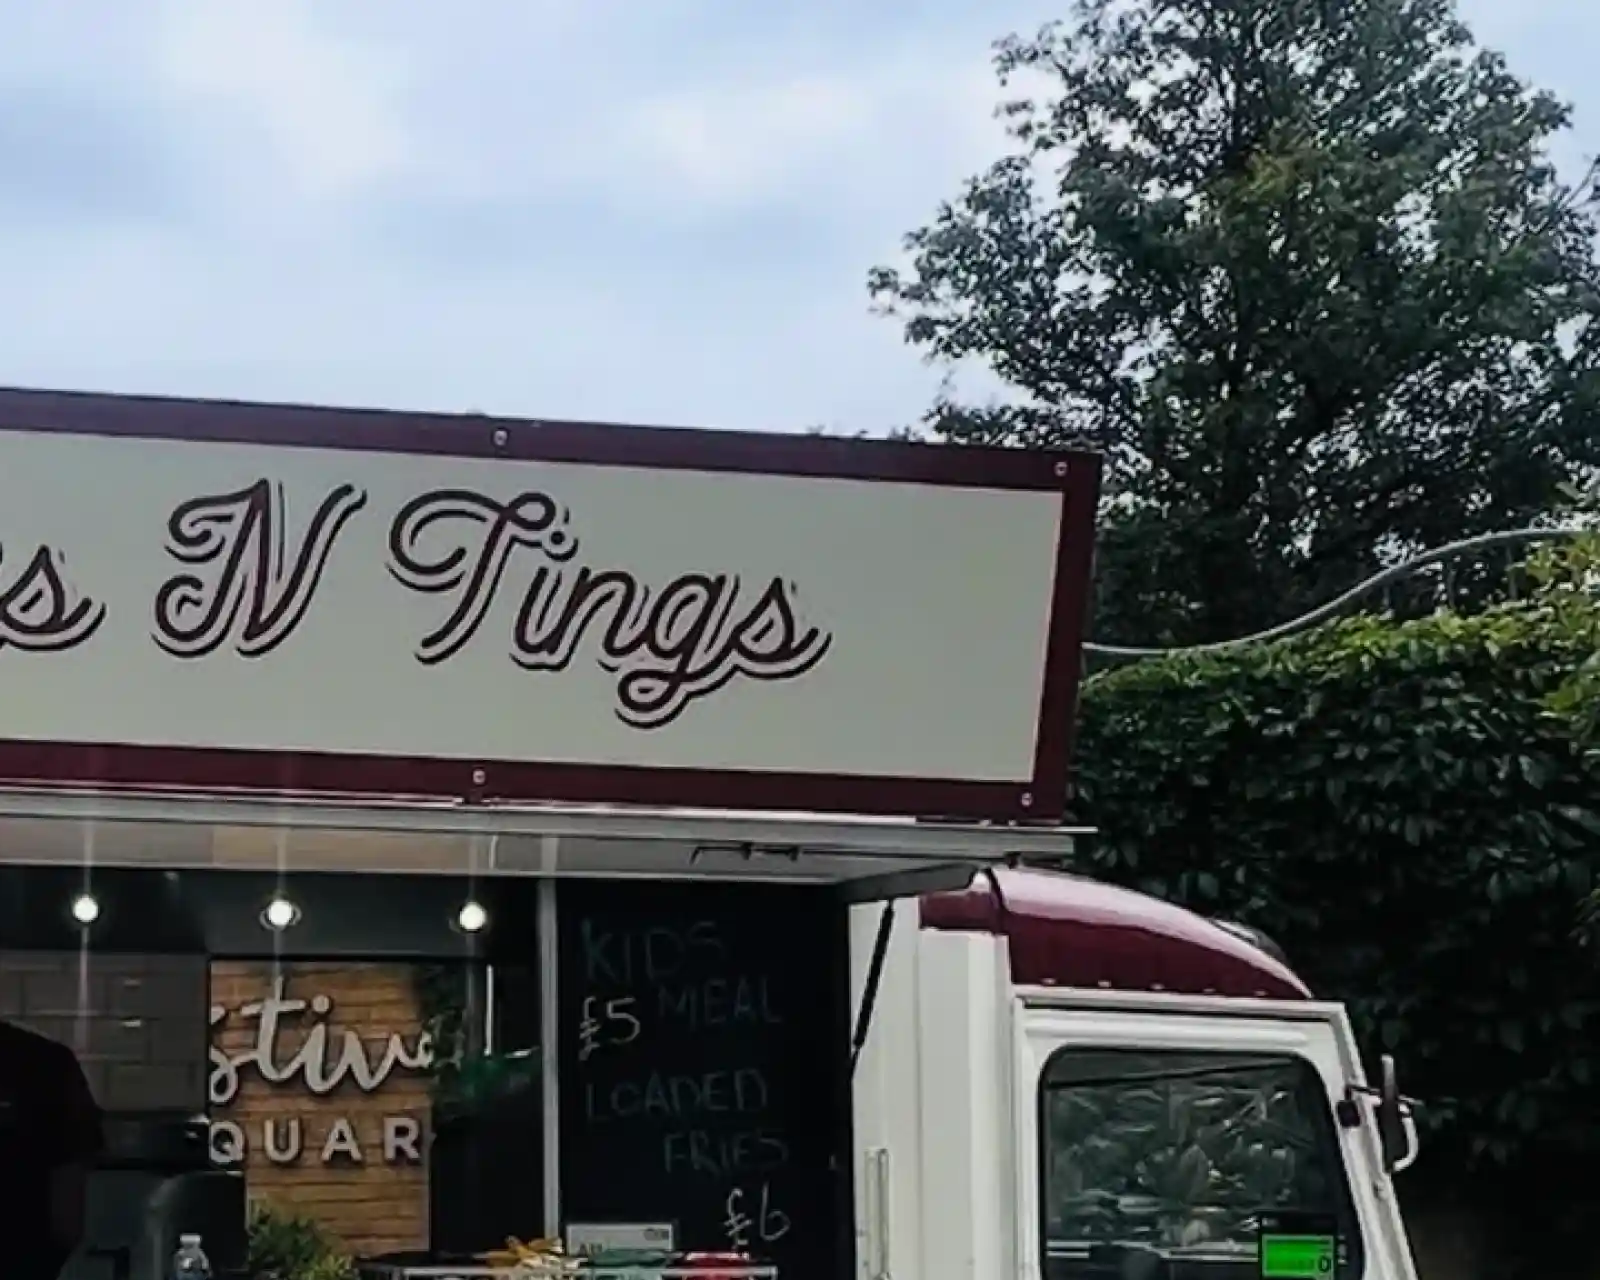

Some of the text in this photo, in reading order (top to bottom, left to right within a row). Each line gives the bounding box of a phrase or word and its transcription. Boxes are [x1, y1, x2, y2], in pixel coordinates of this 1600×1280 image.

[151, 476, 367, 664] N
[386, 488, 835, 729] Tings
[582, 918, 722, 988] KIDS
[578, 996, 641, 1061] £5
[658, 974, 782, 1031] MEAL
[586, 1066, 769, 1124] LOADED
[209, 1117, 421, 1163] QUAR
[663, 1126, 790, 1176] FRIES
[724, 1181, 792, 1250] £6
